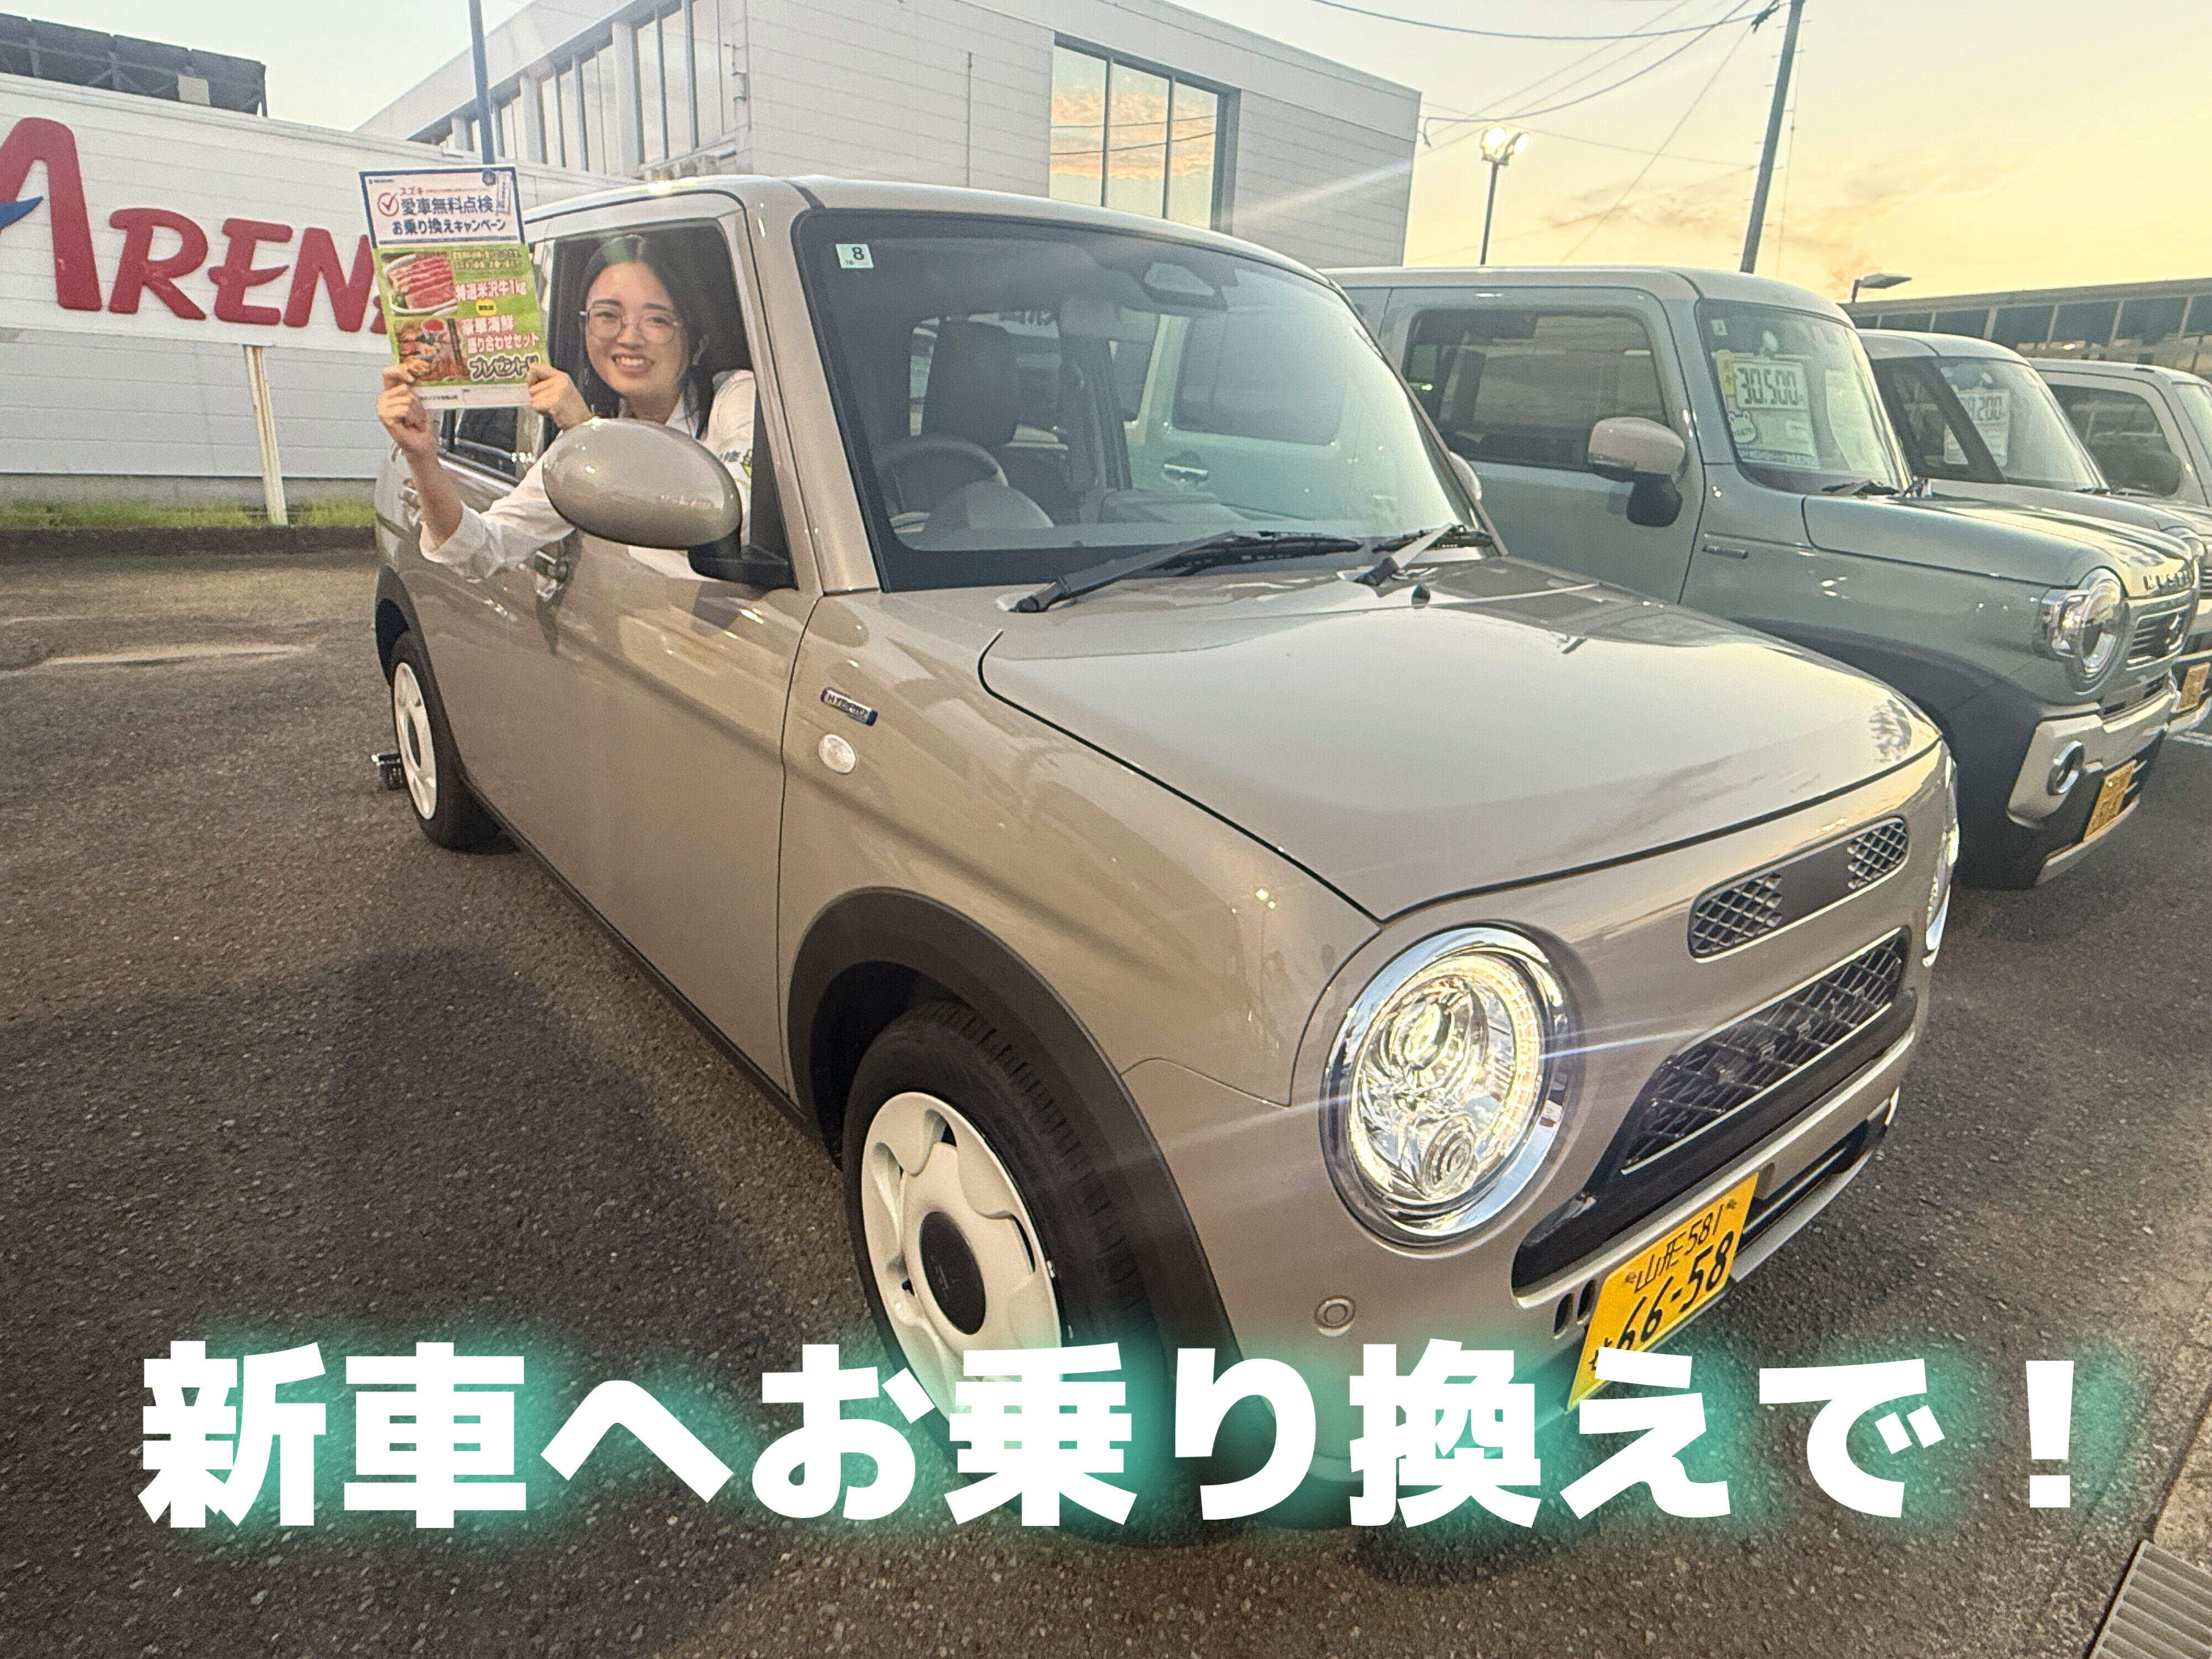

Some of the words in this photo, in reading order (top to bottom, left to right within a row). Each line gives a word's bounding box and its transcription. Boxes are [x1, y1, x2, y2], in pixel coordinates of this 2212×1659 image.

[400, 195, 494, 216] 愛車無料点検
[0, 117, 387, 335] AREN
[392, 218, 506, 236] お乗り換えキャンペーン
[852, 247, 864, 260] 8
[1684, 1203, 1724, 1255] 581
